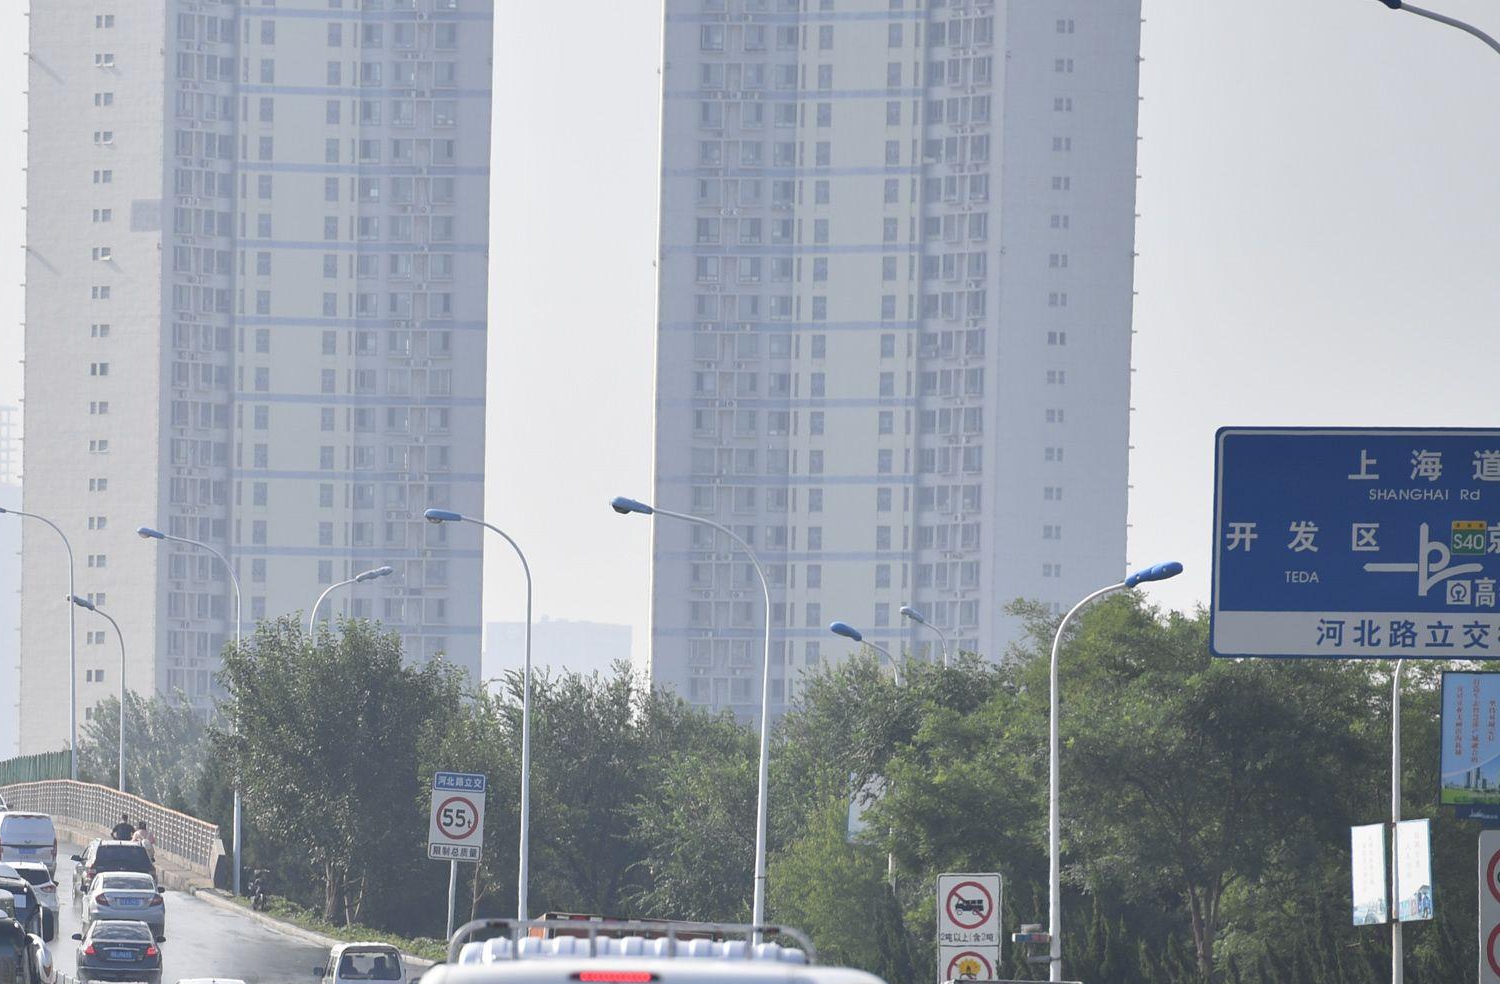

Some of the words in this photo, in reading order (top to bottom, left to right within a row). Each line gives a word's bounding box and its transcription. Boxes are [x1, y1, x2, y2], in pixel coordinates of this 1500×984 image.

[1348, 449, 1500, 482] 上海道
[1369, 489, 1449, 501] SHANGHAI
[1460, 489, 1480, 501] Rd
[1226, 521, 1380, 552] 开发区
[1453, 533, 1485, 550] S40
[1285, 571, 1320, 583] TEDA
[1475, 577, 1500, 608] 高
[1316, 619, 1500, 649] 河北路立交
